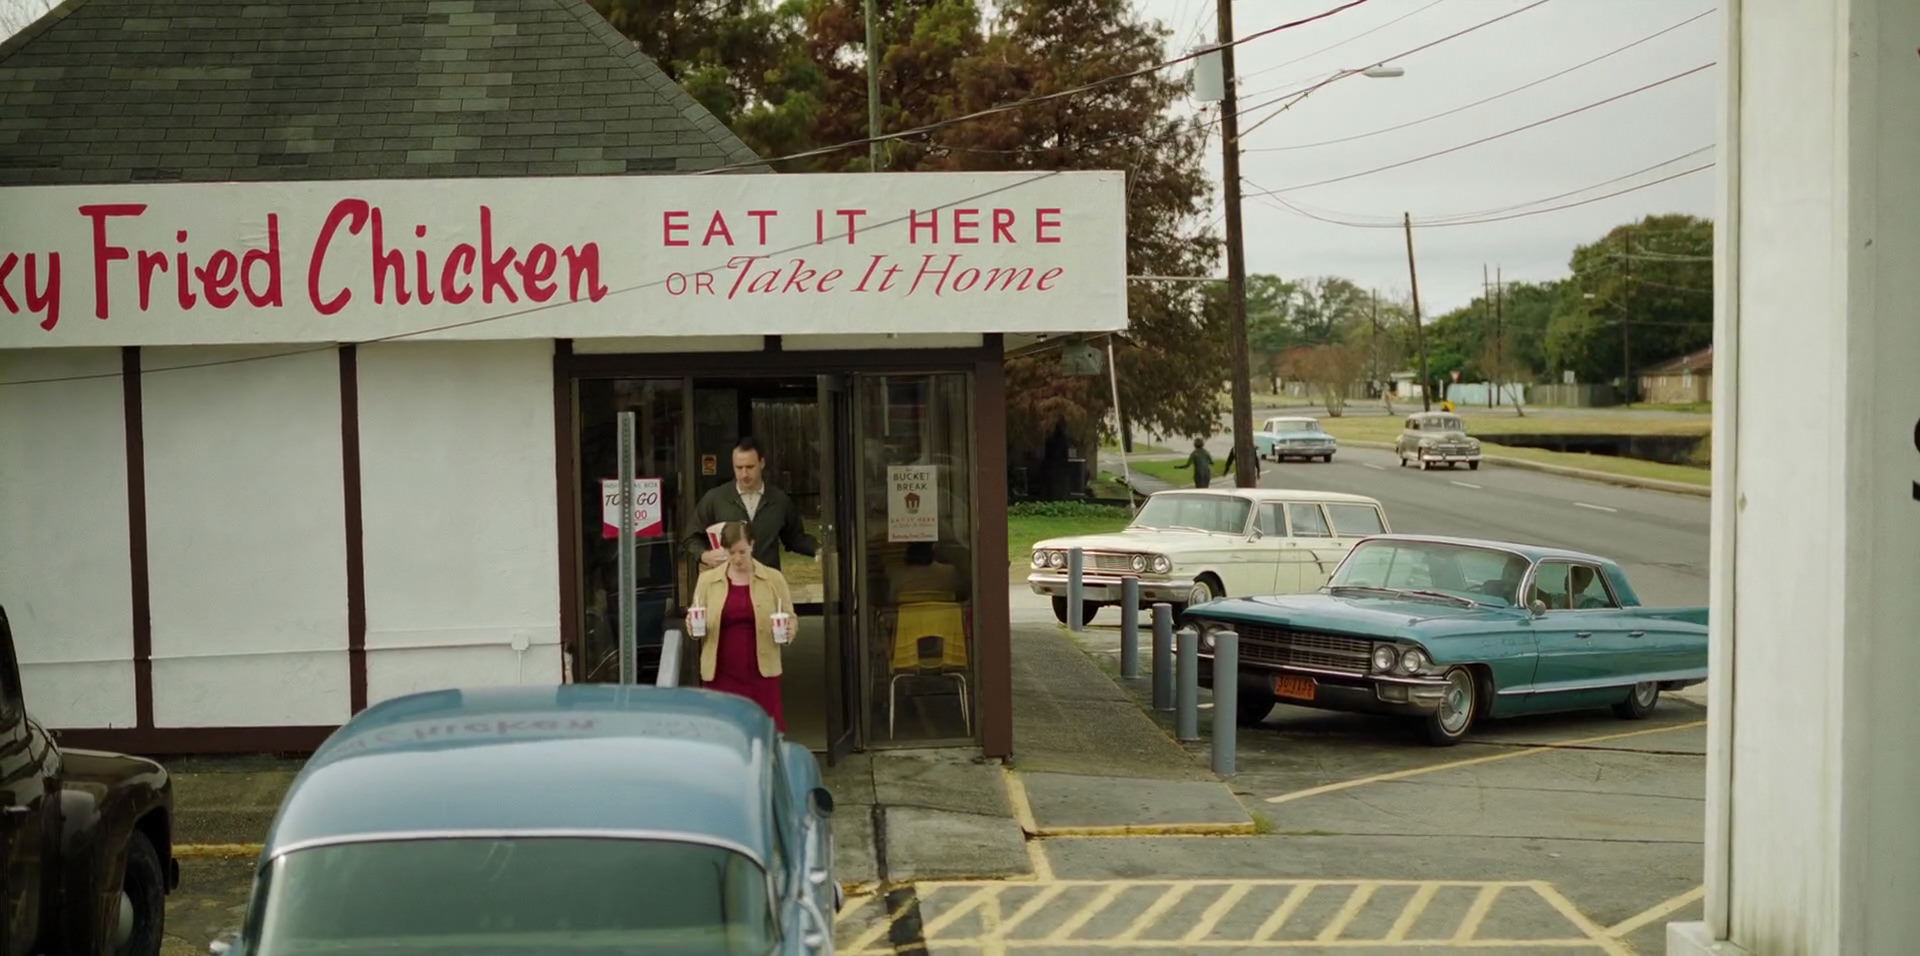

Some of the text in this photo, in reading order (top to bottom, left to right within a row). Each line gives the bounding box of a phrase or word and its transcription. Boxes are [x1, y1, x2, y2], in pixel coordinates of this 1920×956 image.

[663, 208, 1063, 247] EAT IT HERE
[79, 204, 283, 320] Fried
[307, 198, 608, 316] Chicken
[666, 253, 1064, 299] OR Take It Home
[893, 472, 928, 481] BUCKET
[896, 483, 927, 491] BREAK
[636, 492, 658, 506] GO
